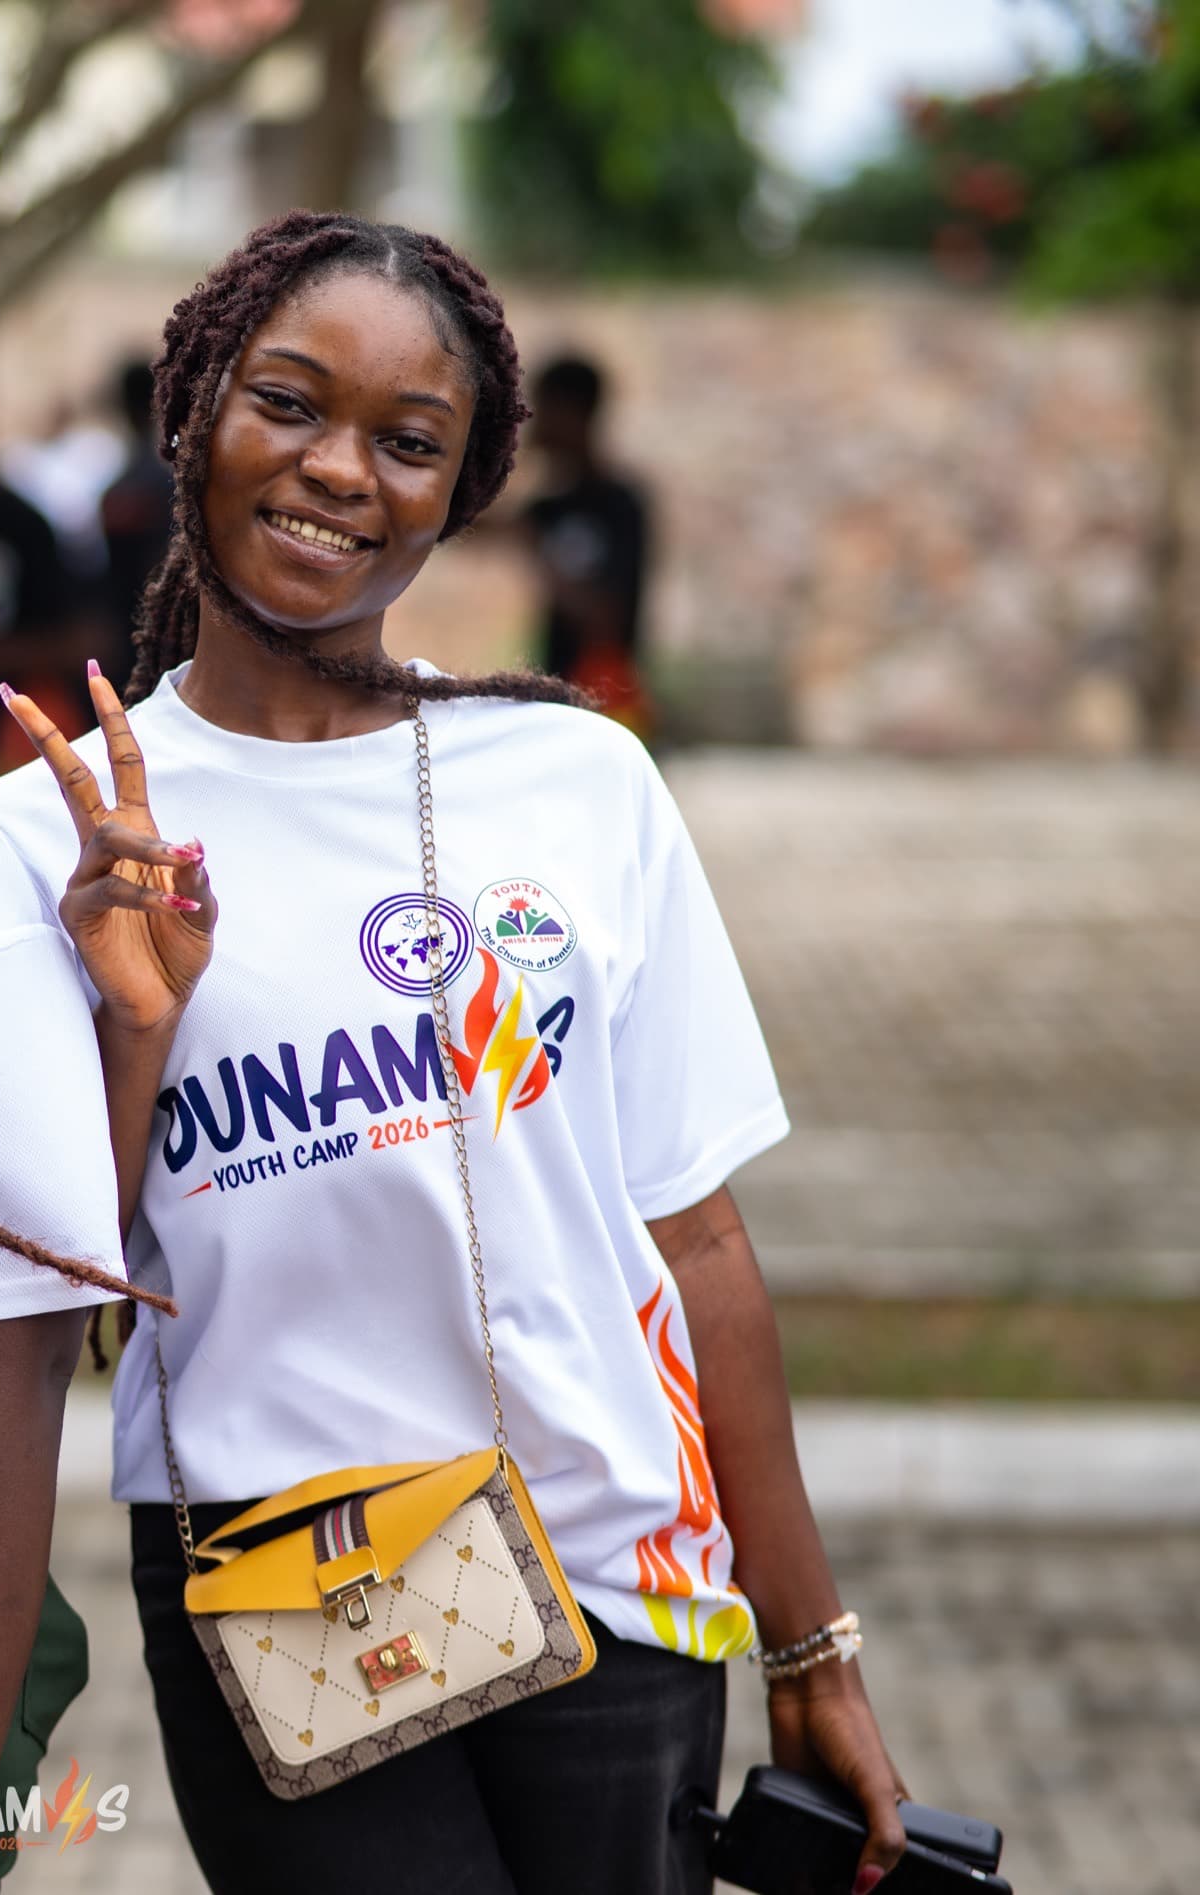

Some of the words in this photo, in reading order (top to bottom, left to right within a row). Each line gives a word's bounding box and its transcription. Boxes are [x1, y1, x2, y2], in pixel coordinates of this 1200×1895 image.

[491, 883, 542, 898] YOUTH
[481, 926, 496, 946] The
[497, 945, 533, 968] Church
[536, 959, 546, 968] of
[502, 936, 527, 945] ARISE
[539, 935, 564, 944] SHINE
[213, 1150, 286, 1192] YOUTH
[294, 1132, 359, 1169] CAMP
[367, 1115, 429, 1150] 2026
